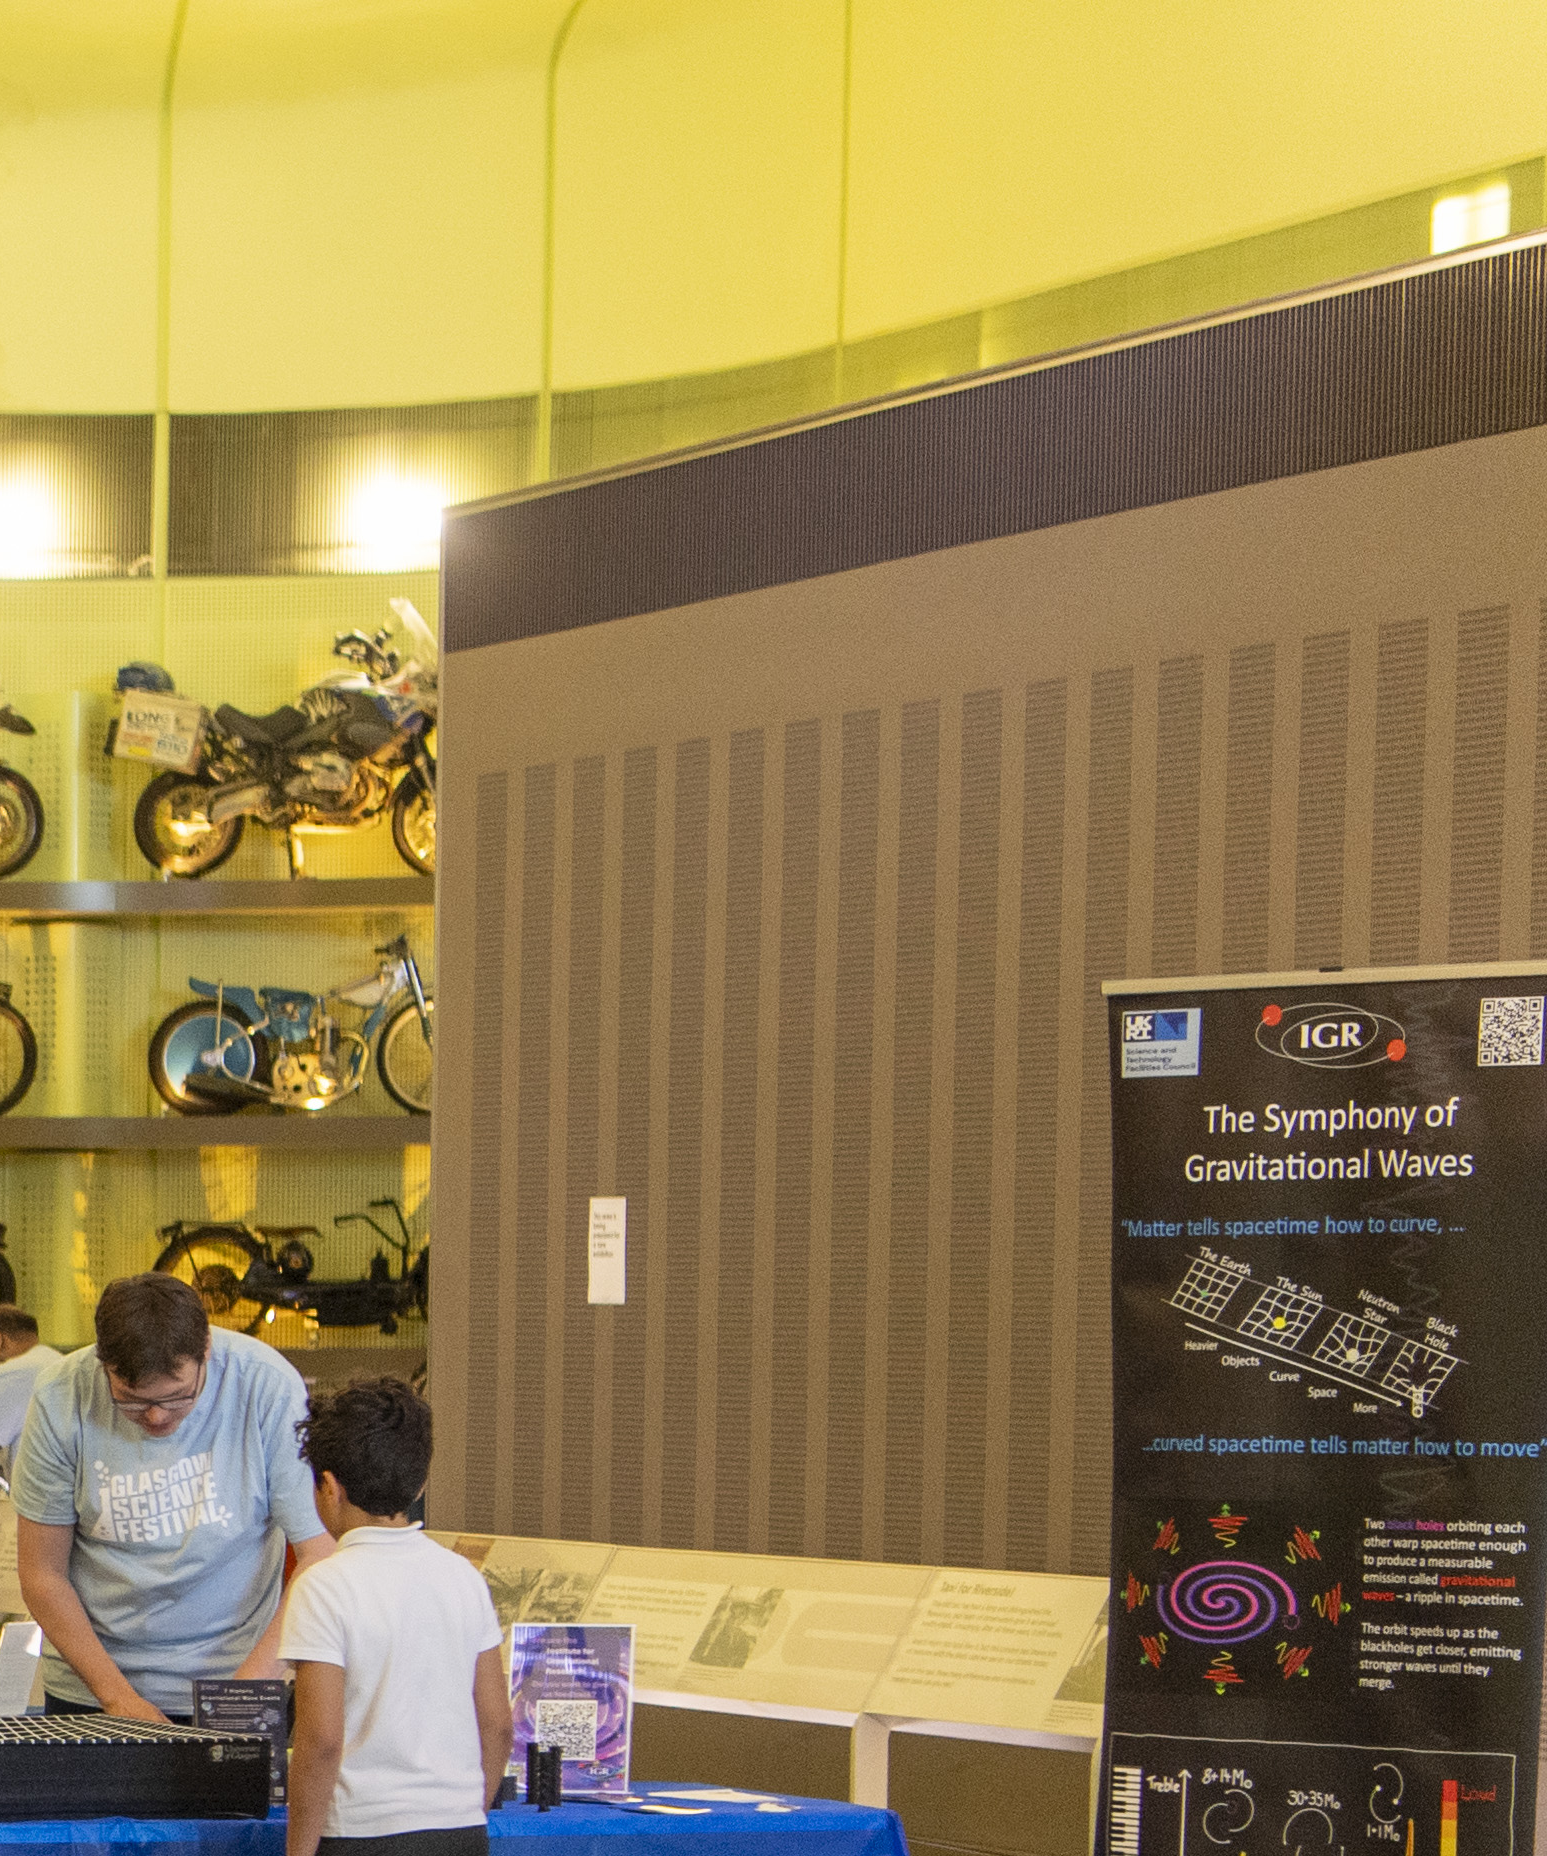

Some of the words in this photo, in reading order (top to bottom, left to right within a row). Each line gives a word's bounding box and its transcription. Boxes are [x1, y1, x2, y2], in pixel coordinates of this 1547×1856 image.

[1300, 1022, 1362, 1049] IGR
[1203, 1104, 1255, 1134] The
[1264, 1099, 1416, 1138] Symphony
[1424, 1096, 1460, 1128] of
[1184, 1149, 1372, 1182] Gravitational
[1378, 1149, 1475, 1178] Waves
[1187, 1217, 1220, 1236] tells
[1224, 1216, 1319, 1238] spacetime
[1325, 1215, 1364, 1234] how
[1368, 1216, 1386, 1234] to
[1389, 1216, 1443, 1234] curve,
[1200, 1245, 1218, 1263] The
[1219, 1255, 1252, 1277] Earth
[1276, 1275, 1298, 1294] The
[1300, 1286, 1324, 1303] Sun
[1357, 1288, 1401, 1315] Neutron
[1362, 1307, 1388, 1325] Star
[1426, 1316, 1459, 1338] Black
[1184, 1340, 1219, 1351] Heavier
[1424, 1333, 1450, 1351] Hole
[1220, 1355, 1260, 1368] Objects
[1268, 1370, 1301, 1383] Curve
[1307, 1386, 1338, 1399] Space
[1353, 1402, 1378, 1414] More
[1208, 1435, 1306, 1456] spacetime
[1310, 1435, 1348, 1455] tells
[1352, 1436, 1410, 1455] matter
[1414, 1436, 1451, 1456] how
[1455, 1438, 1476, 1456] to
[110, 1450, 213, 1498] GLASGOW
[111, 1471, 218, 1521] SCIENCE
[115, 1500, 223, 1543] FESTIVAL
[1364, 1517, 1386, 1530] Two
[1415, 1519, 1446, 1531] holes
[1446, 1520, 1493, 1535] orbiting
[1494, 1521, 1526, 1534] each
[1363, 1536, 1392, 1548] other
[1393, 1539, 1419, 1550] warp
[1420, 1539, 1476, 1552] spacetime
[1478, 1540, 1528, 1555] enough
[1363, 1554, 1375, 1566] to
[1376, 1555, 1417, 1568] produce
[1419, 1558, 1426, 1567] a
[1427, 1556, 1494, 1569] measurable
[1362, 1572, 1407, 1584] emission
[1408, 1573, 1439, 1585] called
[1439, 1575, 1516, 1588] gravitational
[1405, 1593, 1412, 1602] a
[1413, 1592, 1443, 1605] ripple
[1445, 1593, 1456, 1604] in
[1458, 1594, 1524, 1607] spacetime.
[1361, 1622, 1381, 1635] The
[1382, 1623, 1409, 1635] orbit
[1410, 1625, 1445, 1639] speeds
[1446, 1628, 1461, 1639] up
[1462, 1629, 1475, 1639] as
[1478, 1627, 1499, 1639] the
[1360, 1640, 1415, 1654] blackholes
[1416, 1644, 1433, 1656] get
[1435, 1643, 1467, 1657] closer,
[1469, 1645, 1522, 1661] emitting
[1359, 1658, 1404, 1673] stronger
[1405, 1662, 1437, 1673] waves
[1439, 1662, 1462, 1673] until
[1463, 1664, 1490, 1677] they
[1358, 1677, 1395, 1691] merge.
[1146, 1774, 1180, 1794] Treble
[1460, 1784, 1497, 1803] Loud
